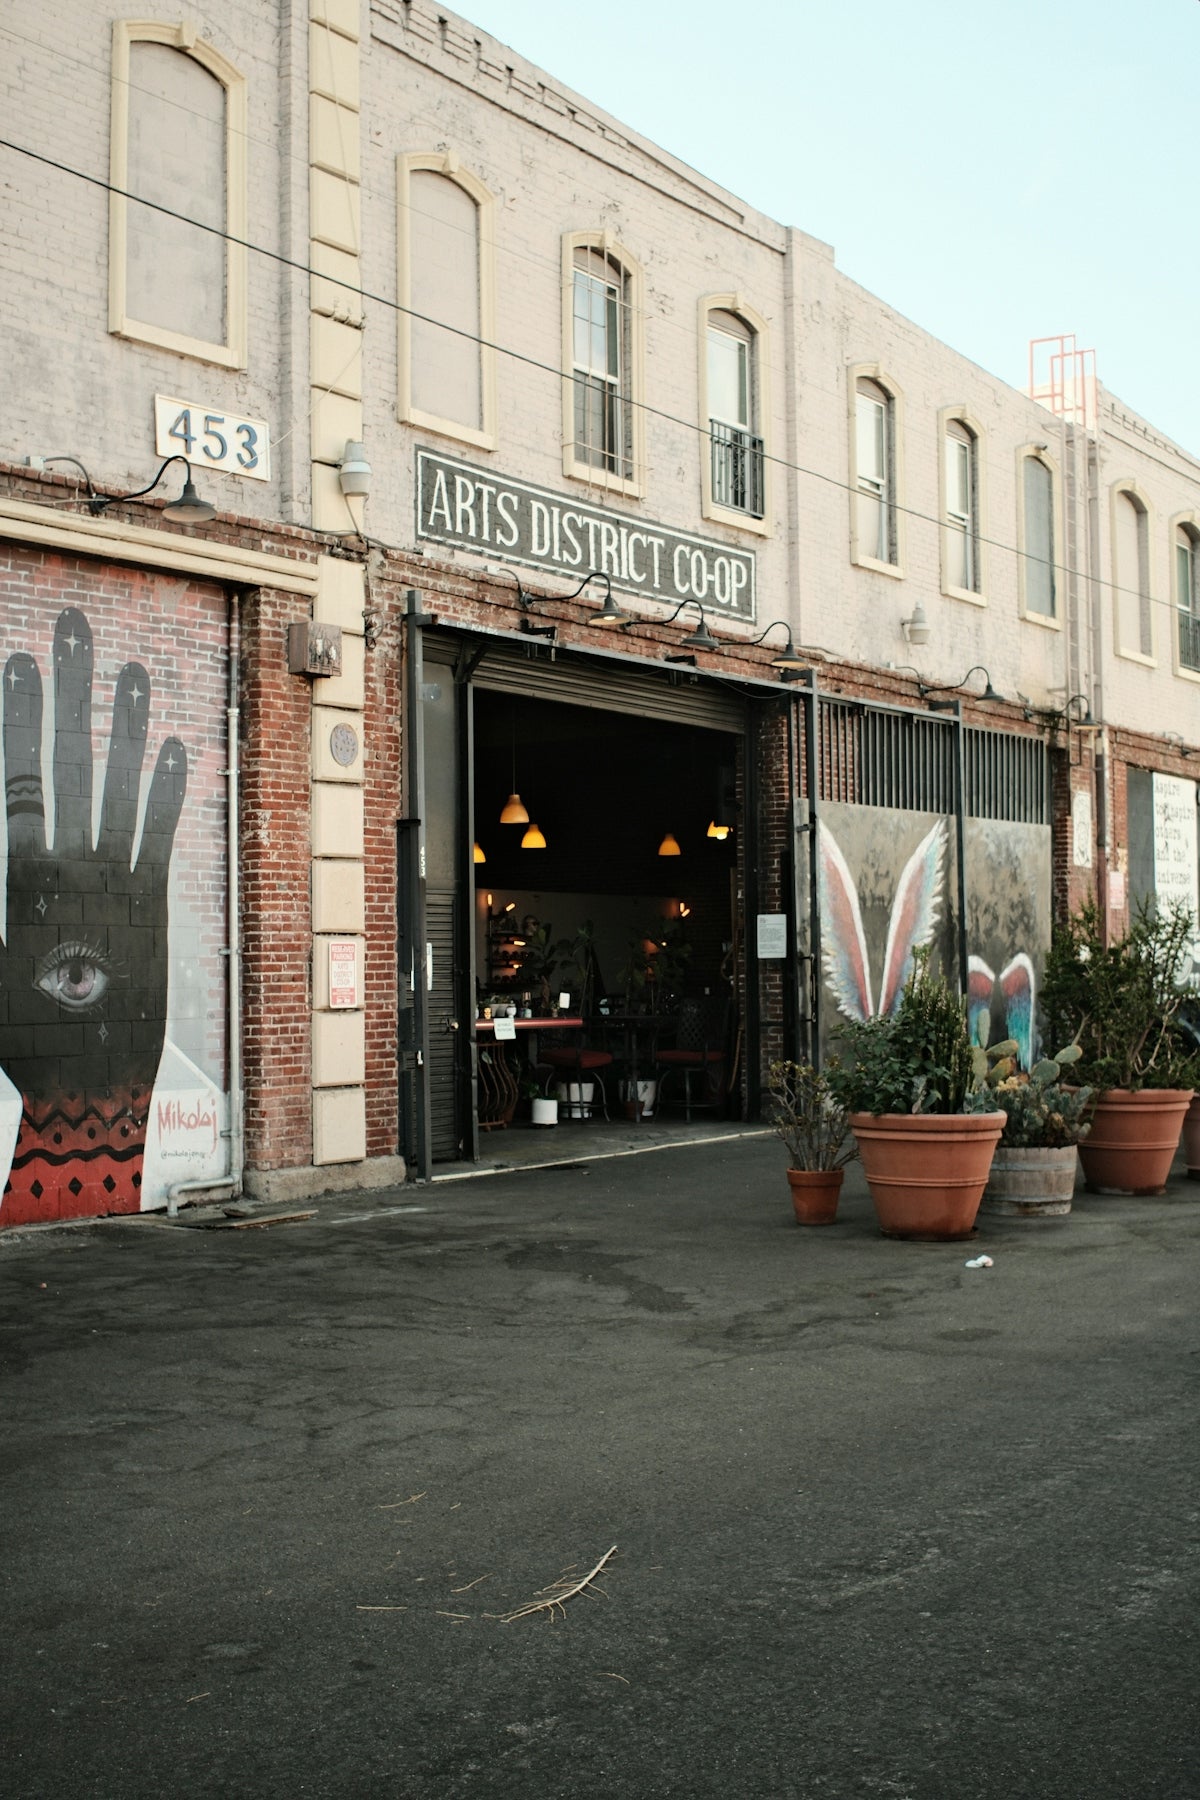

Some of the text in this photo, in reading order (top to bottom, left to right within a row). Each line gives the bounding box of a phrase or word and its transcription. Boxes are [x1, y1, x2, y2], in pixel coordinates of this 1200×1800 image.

[169, 409, 259, 469] 453
[428, 469, 748, 607] ARTS DISTRICT CO-OP
[157, 1098, 217, 1154] Mikolaj
